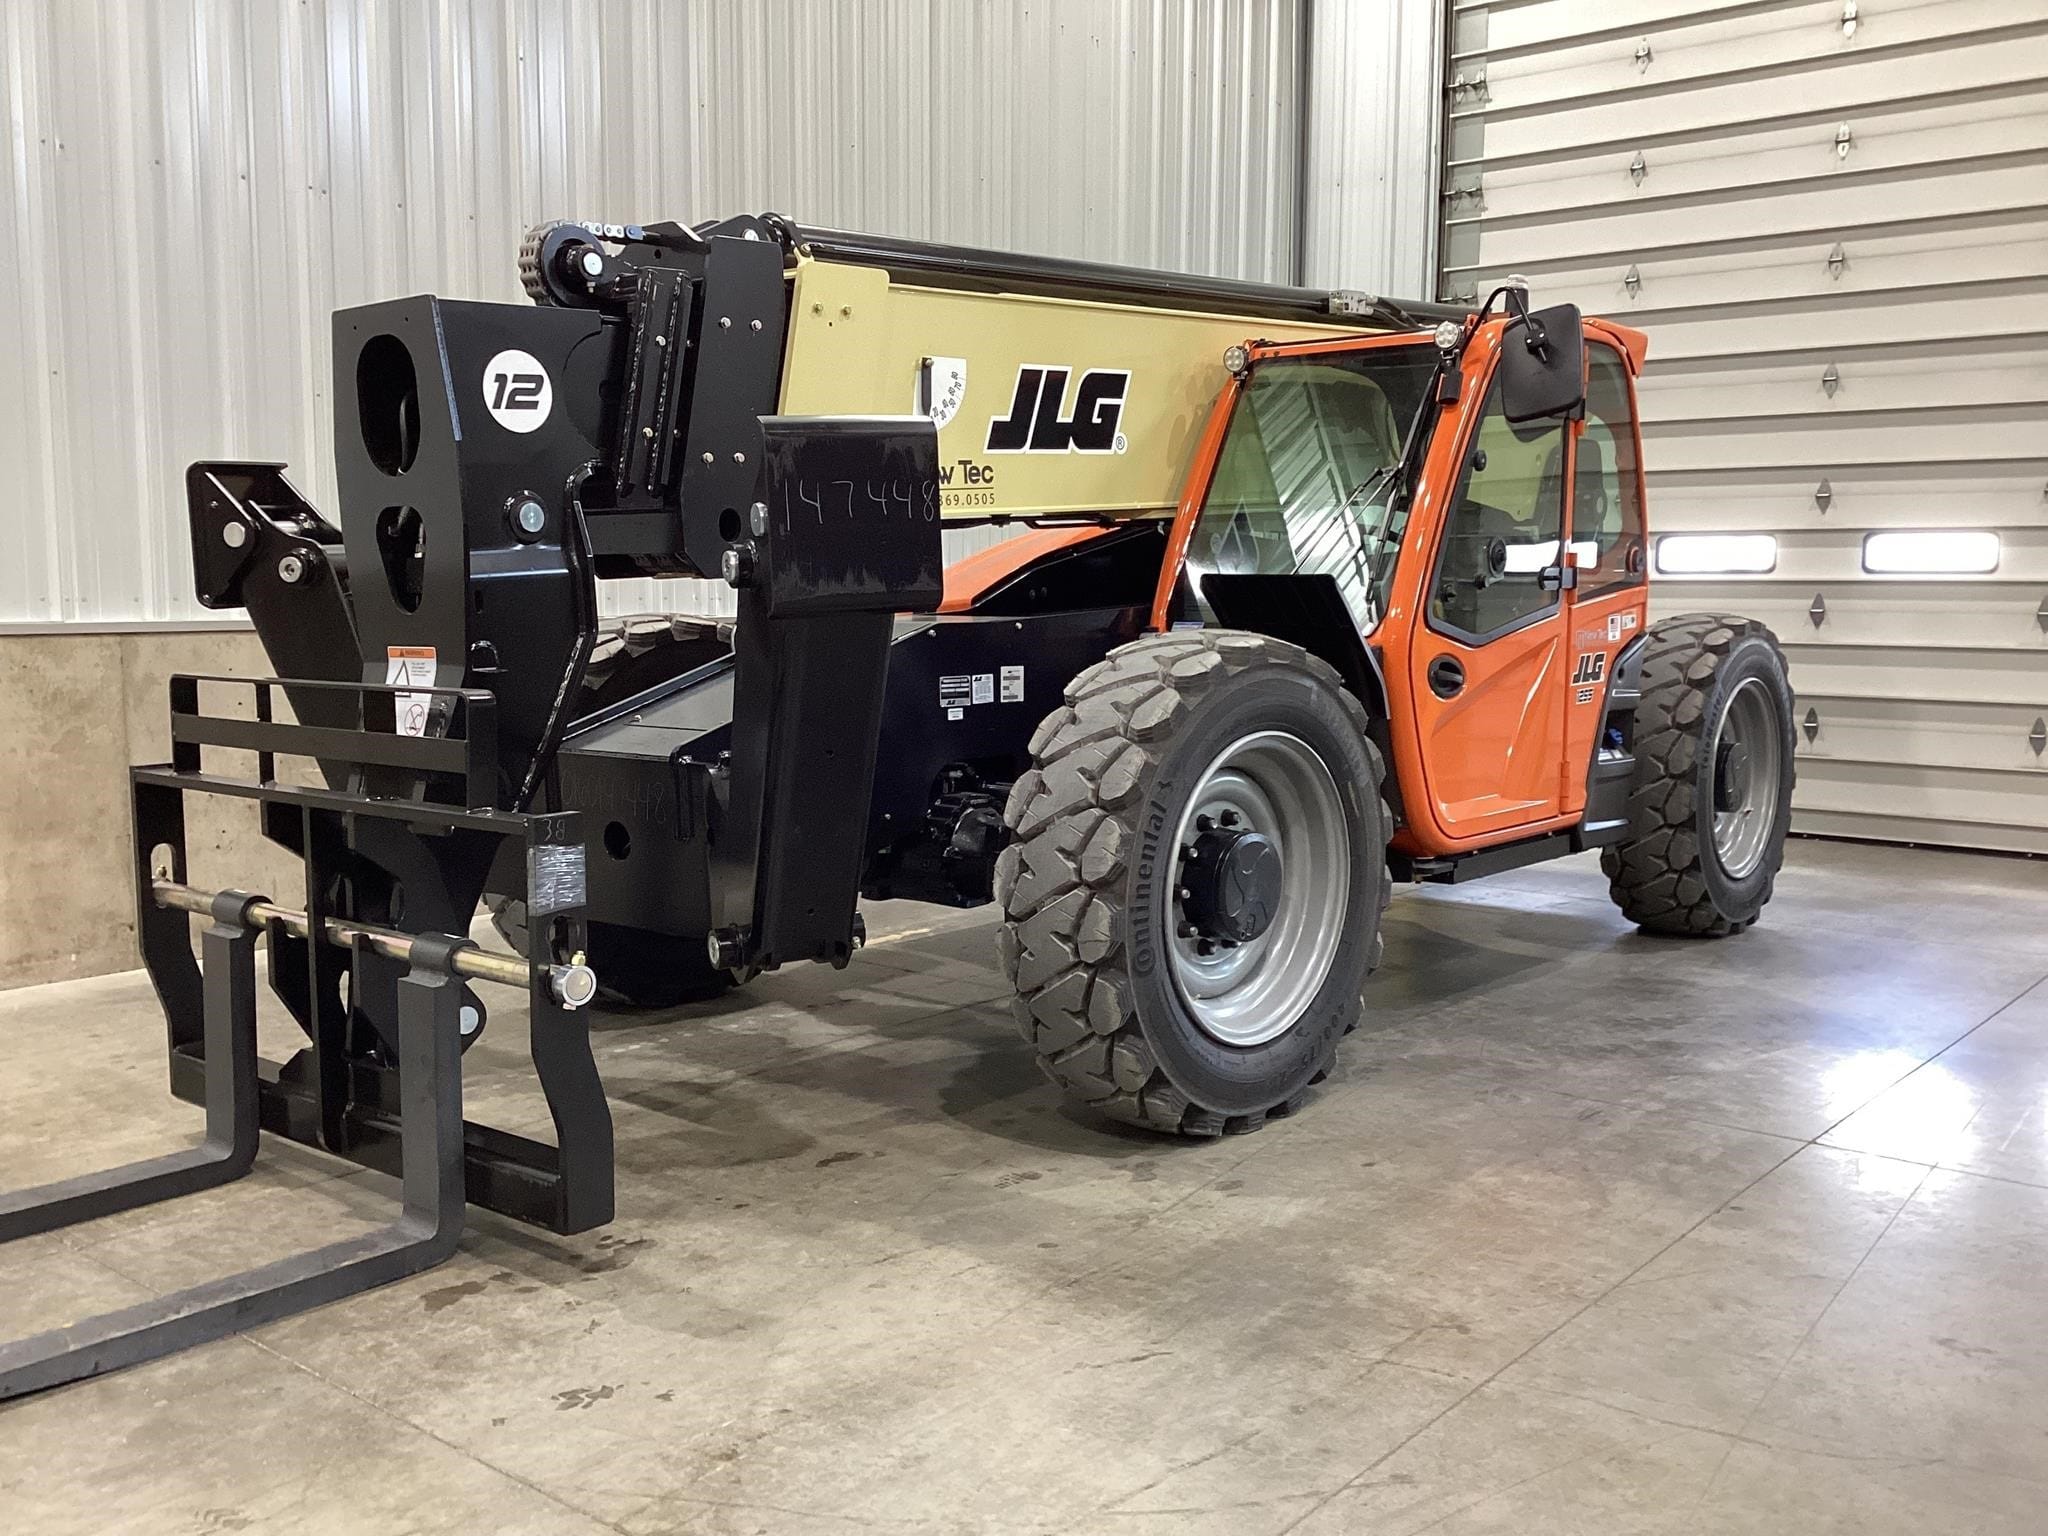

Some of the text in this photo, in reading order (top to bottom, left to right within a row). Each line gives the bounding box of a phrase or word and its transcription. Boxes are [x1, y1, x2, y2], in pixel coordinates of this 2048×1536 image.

[492, 373, 545, 410] 12
[986, 367, 1129, 451] JLG
[957, 459, 995, 485] Tec
[784, 478, 936, 532] 147448
[1571, 652, 1606, 685] JLG
[541, 817, 567, 842] 38
